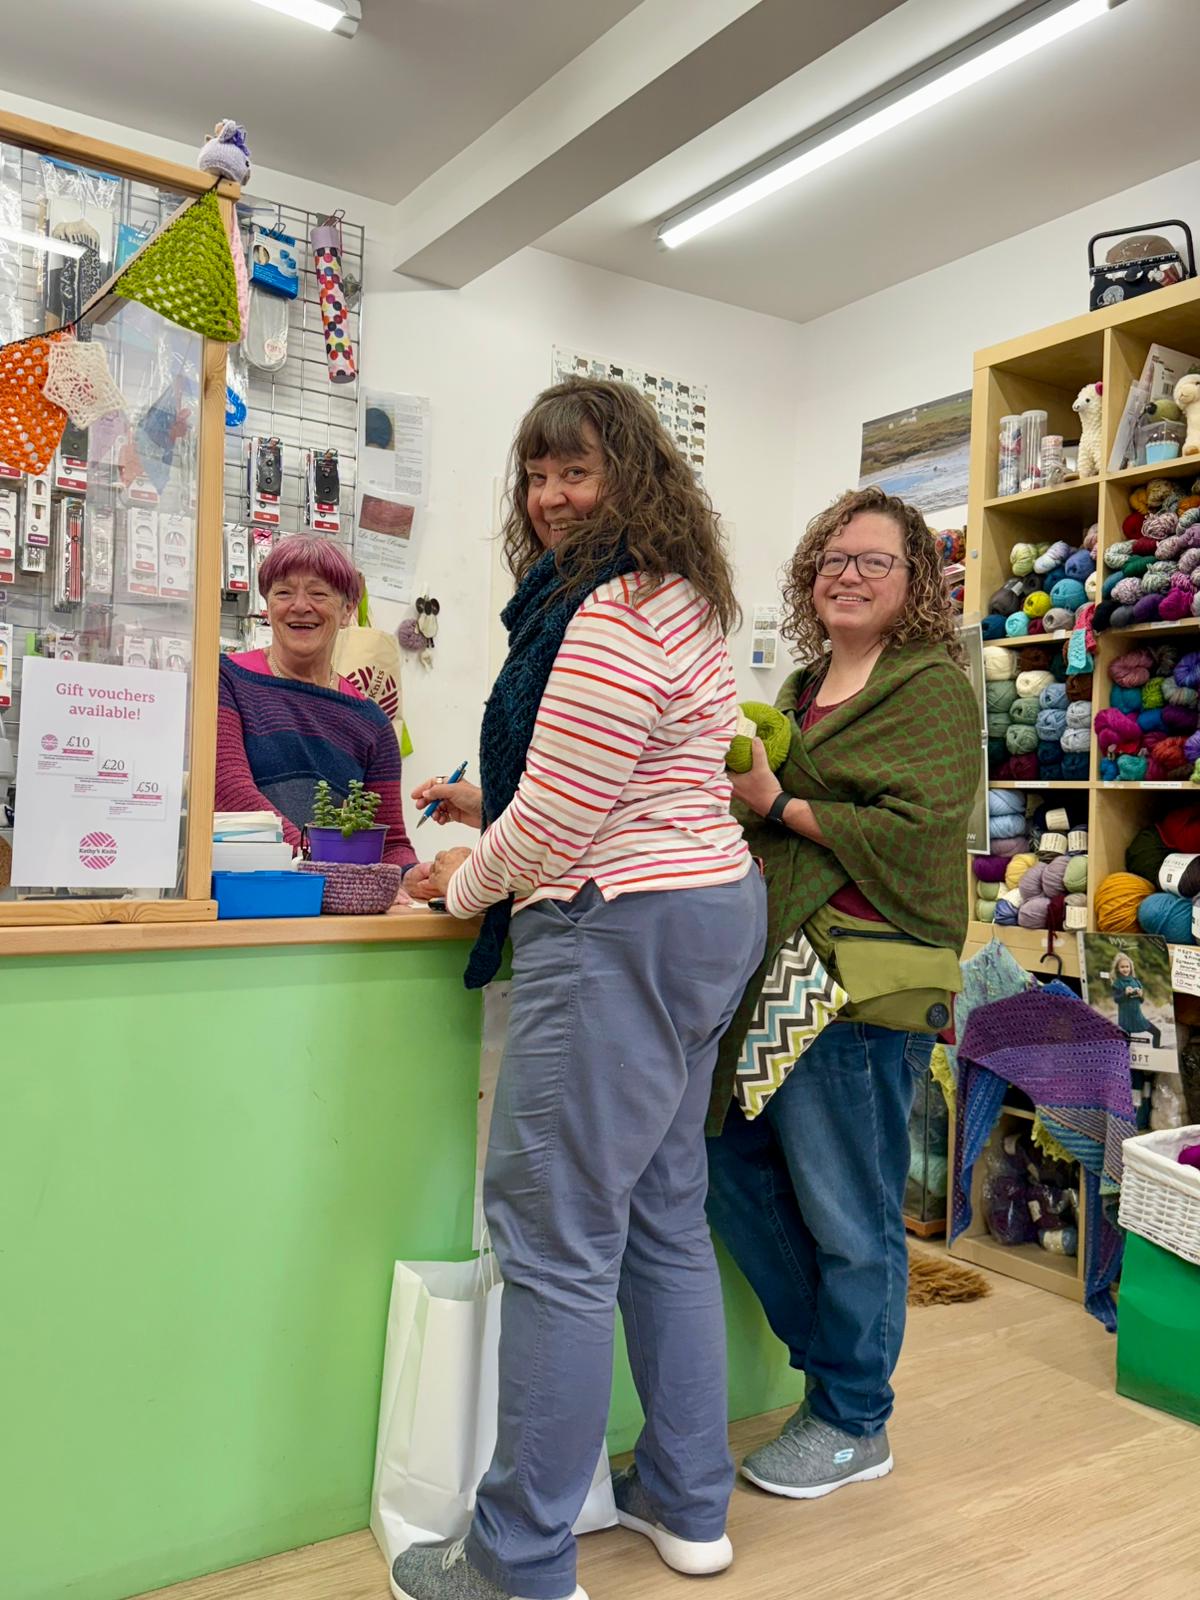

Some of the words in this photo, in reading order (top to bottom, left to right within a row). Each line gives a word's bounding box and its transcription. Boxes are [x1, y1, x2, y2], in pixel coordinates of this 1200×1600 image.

[368, 670, 385, 698] Knits
[56, 682, 84, 697] Gift
[88, 687, 156, 703] vouchers
[69, 704, 141, 720] available!
[66, 736, 90, 748] £10
[102, 759, 125, 771] £20
[136, 782, 159, 793] £50
[1131, 1053, 1149, 1063] OFT
